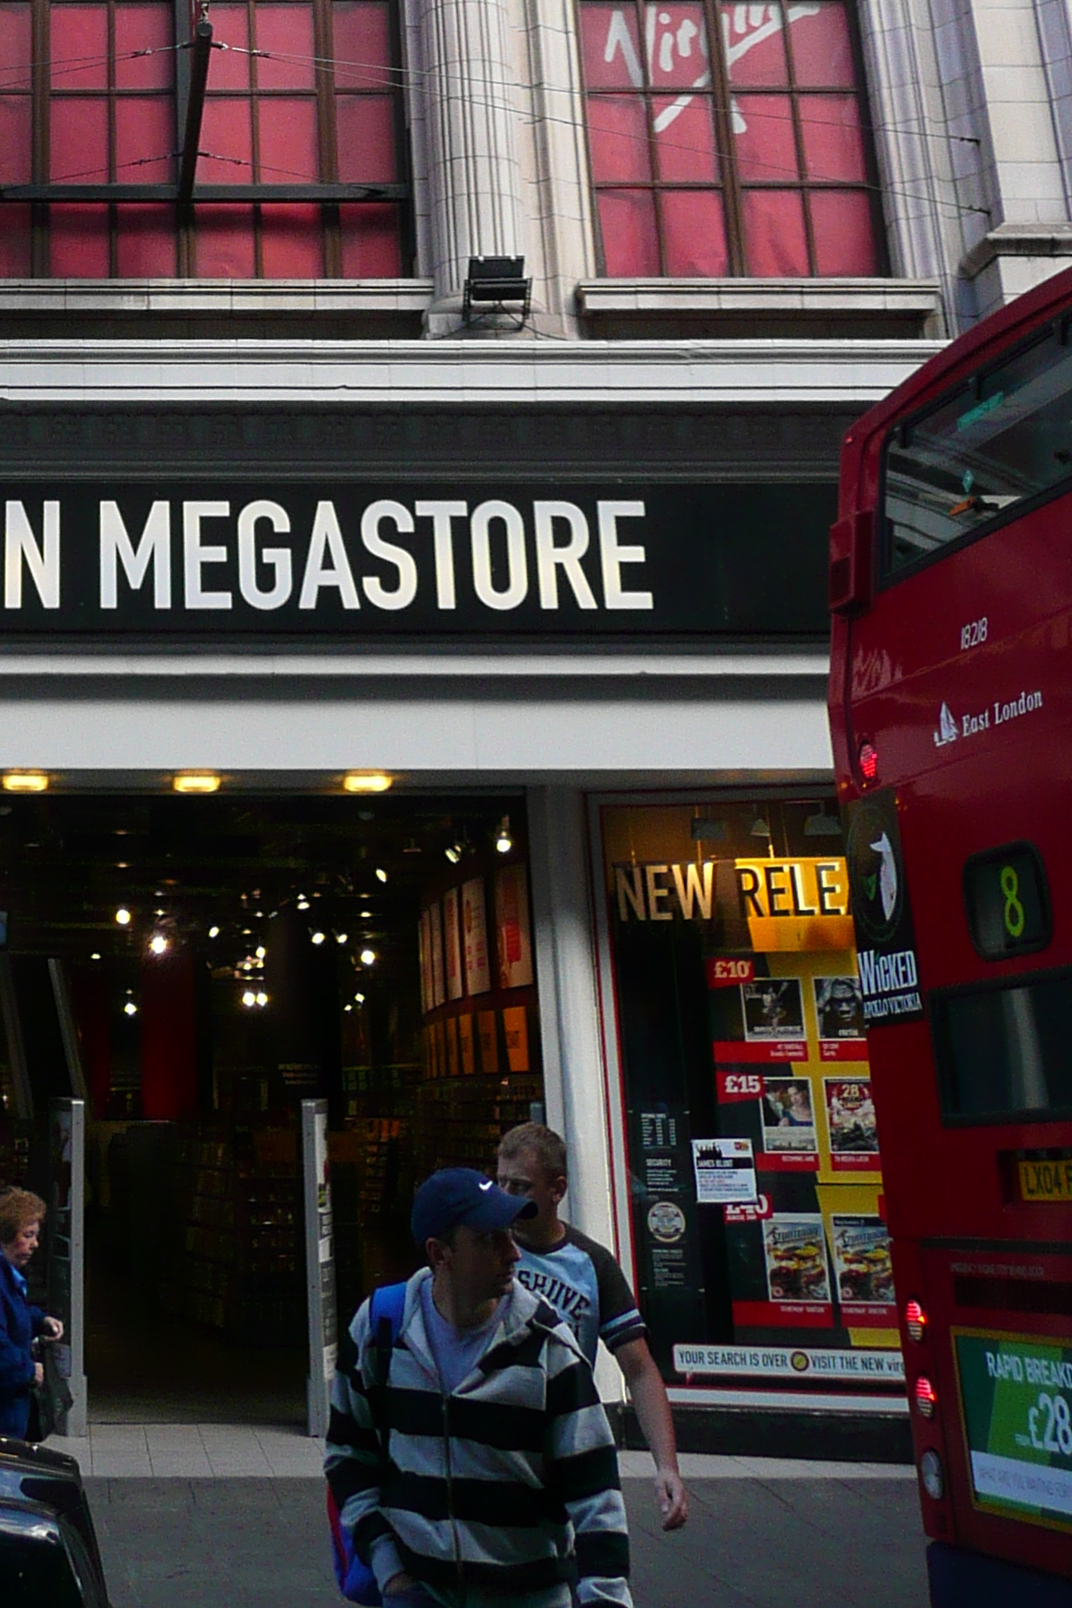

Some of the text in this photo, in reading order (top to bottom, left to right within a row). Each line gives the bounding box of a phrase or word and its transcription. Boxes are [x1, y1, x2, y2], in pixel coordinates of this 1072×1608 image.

[100, 499, 655, 610] MEGASTORE
[960, 616, 988, 650] 18218
[961, 690, 1044, 737] East London
[613, 862, 850, 922] NEW RELE
[1000, 865, 1026, 938] 8
[713, 960, 751, 979] £10
[724, 1074, 761, 1094] £15
[841, 1083, 861, 1097] 28
[678, 1350, 706, 1366] YOUR
[707, 1351, 747, 1367] SEARCH
[749, 1353, 760, 1367] IS
[761, 1353, 789, 1368] OVER
[811, 1355, 837, 1370] VISIT
[839, 1356, 859, 1371] THE
[860, 1357, 884, 1372] NEW
[985, 1351, 1023, 1383] RAPID
[1028, 1392, 1072, 1455] £28
